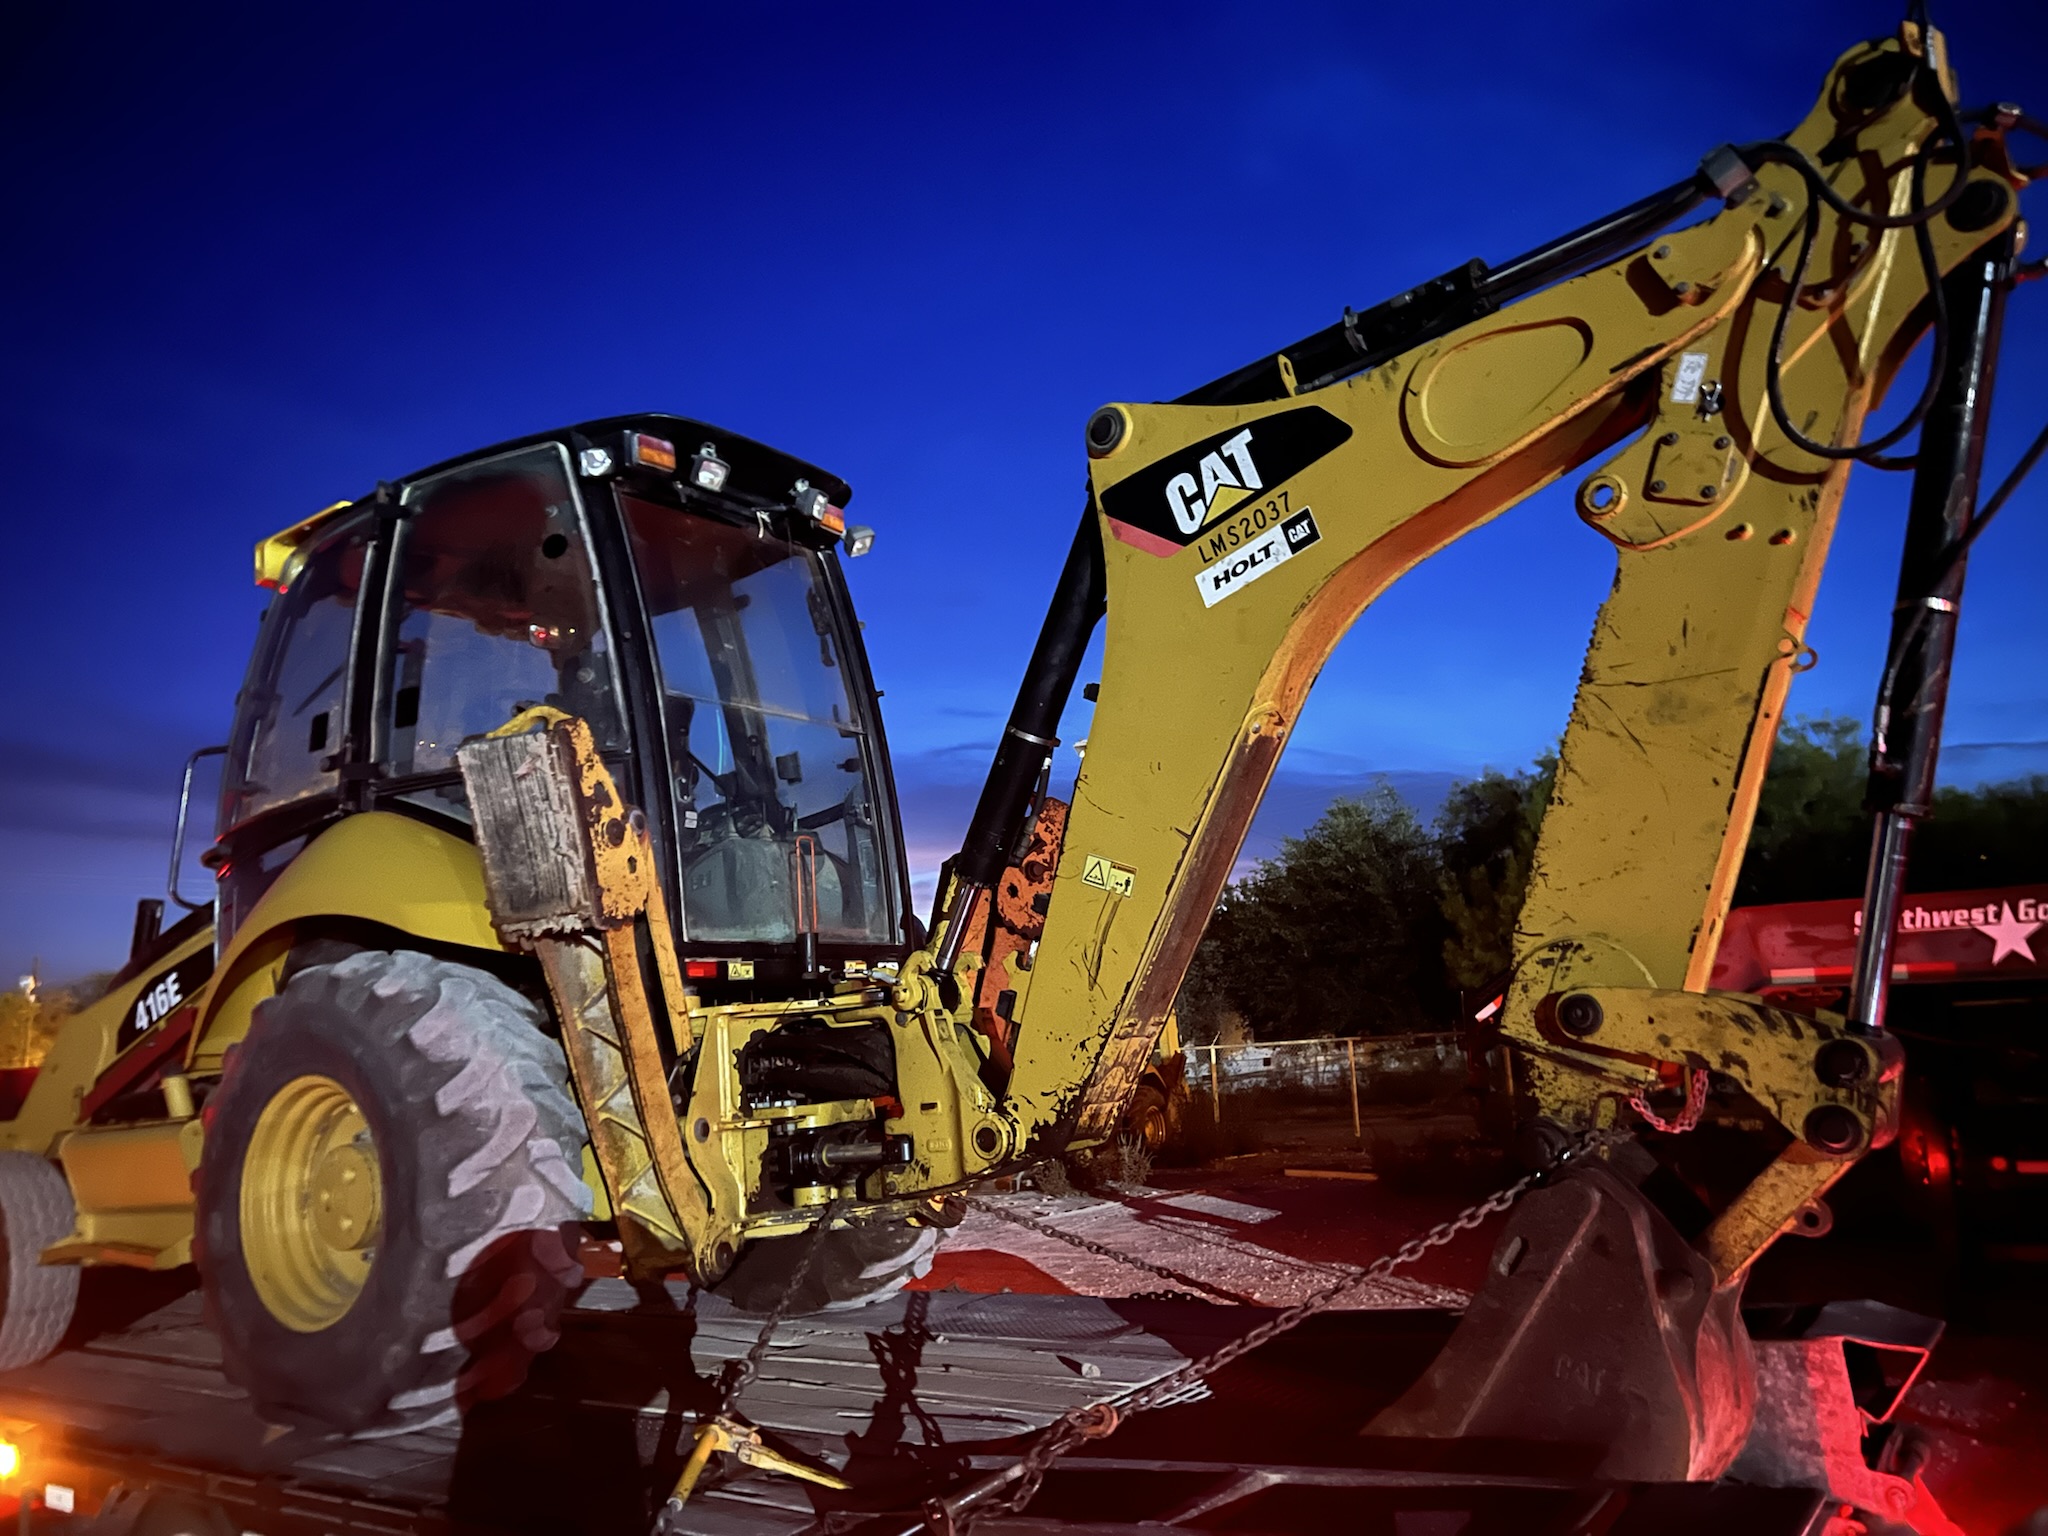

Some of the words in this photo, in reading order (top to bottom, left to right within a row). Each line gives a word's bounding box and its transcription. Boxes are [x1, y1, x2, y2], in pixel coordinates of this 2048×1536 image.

[1165, 428, 1264, 535] CAT
[1197, 491, 1291, 564] LMS2037
[1213, 541, 1276, 591] HOLT
[1287, 519, 1312, 544] CAT
[1854, 903, 1999, 936] thwest
[135, 972, 184, 1031] 416E
